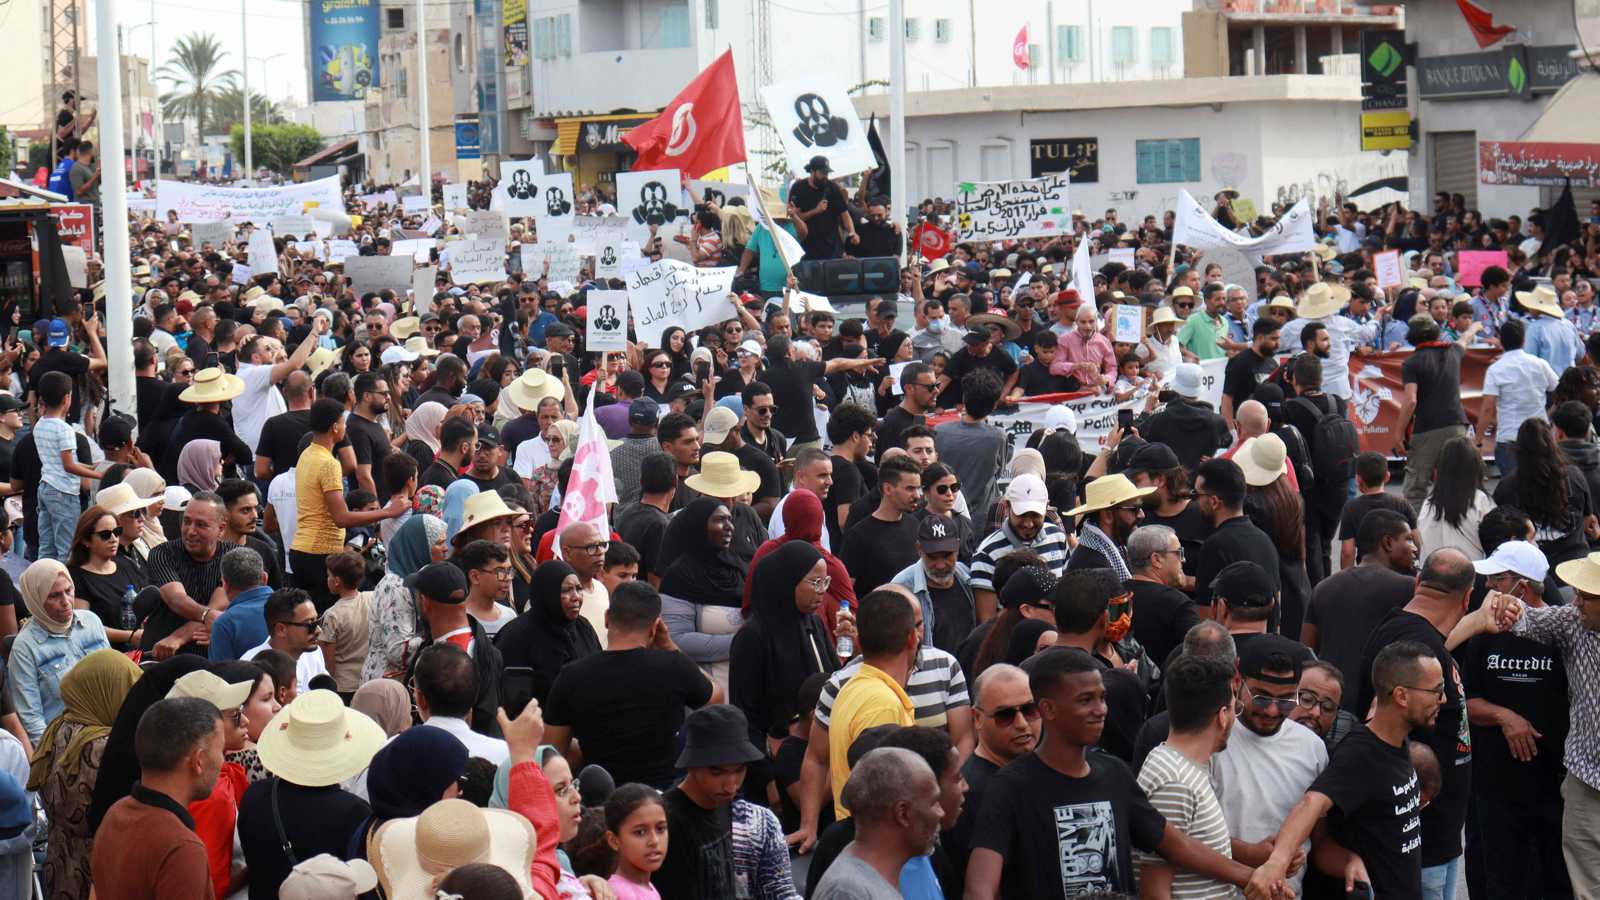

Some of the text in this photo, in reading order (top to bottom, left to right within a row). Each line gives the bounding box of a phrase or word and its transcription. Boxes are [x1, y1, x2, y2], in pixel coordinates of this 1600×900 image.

[1426, 67, 1461, 87] BANQUE
[1000, 206, 1027, 219] 2017
[1487, 654, 1553, 671] Accredit
